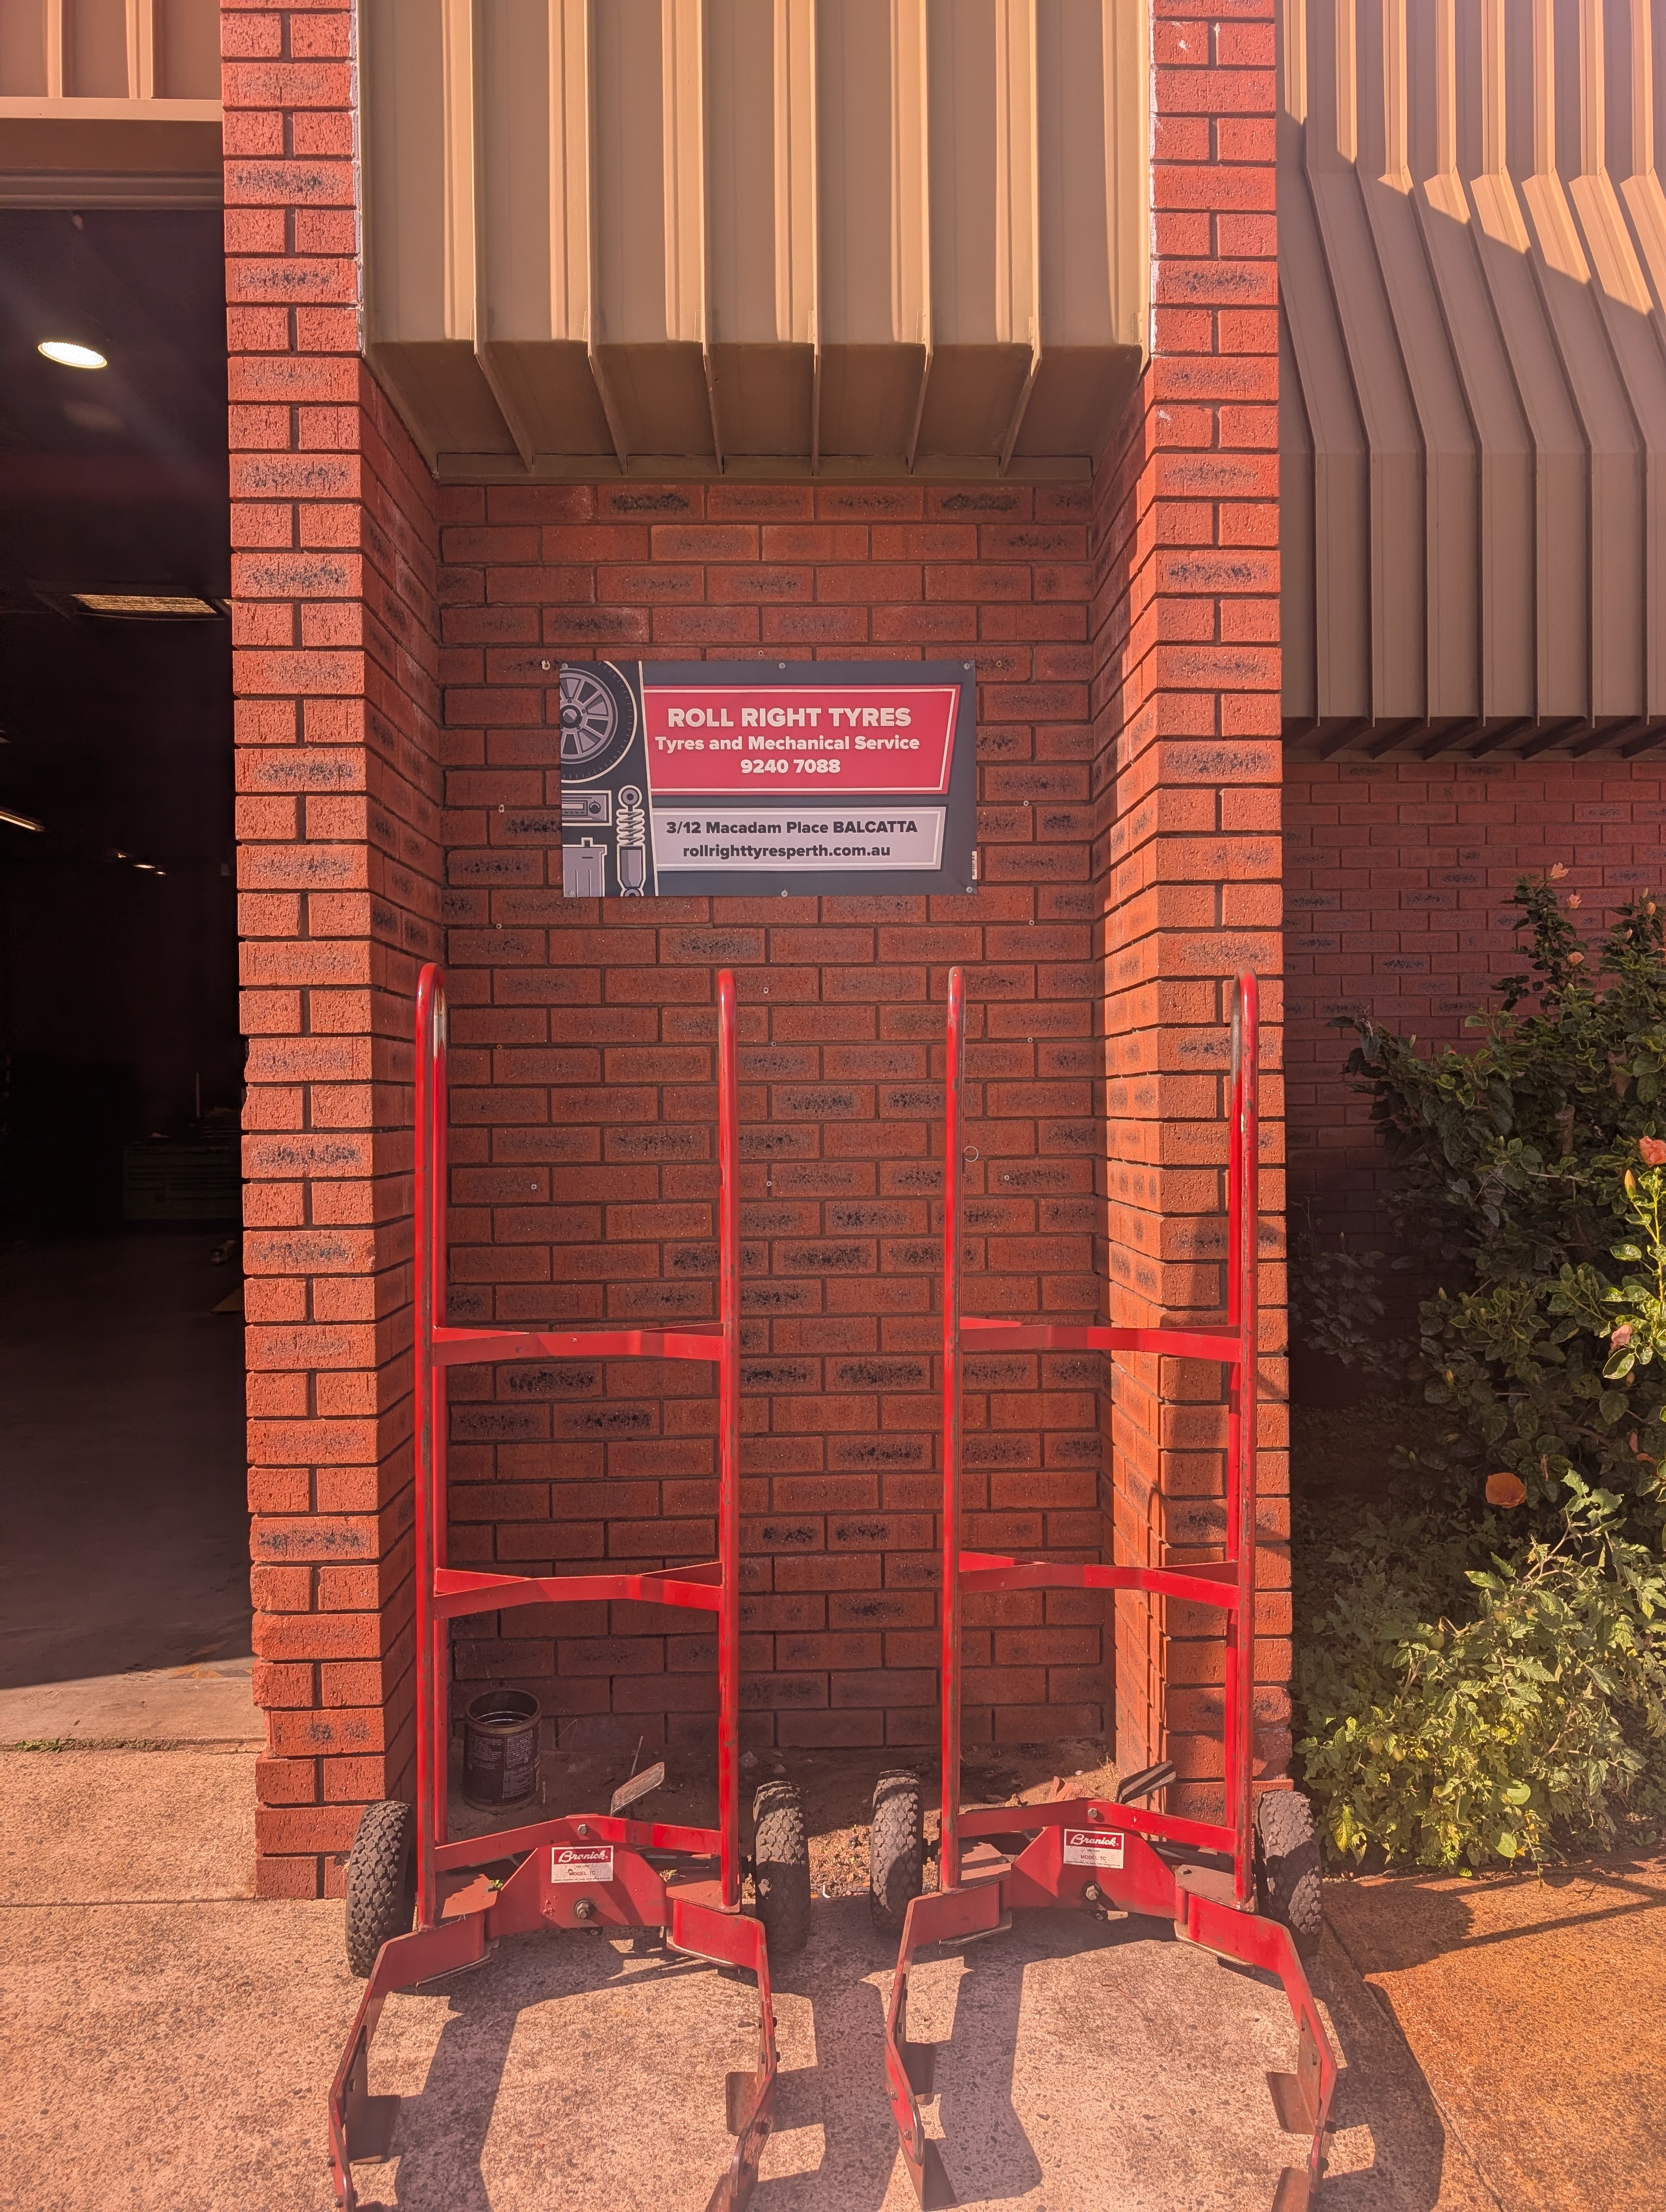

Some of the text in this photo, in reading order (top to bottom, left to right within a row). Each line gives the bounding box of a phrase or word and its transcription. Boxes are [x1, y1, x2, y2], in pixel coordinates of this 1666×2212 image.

[668, 708, 912, 727] ROLL RIGHT TYRES
[655, 734, 920, 754] Tyres and Mechanical Service
[741, 759, 841, 774] 9240 7088
[666, 820, 918, 834] 3/12 Macadam Place BALCATTA
[683, 844, 890, 860] rollrighttyresperth.com.au
[1070, 1834, 1117, 1847] Branick
[558, 1850, 605, 1863] Branick
